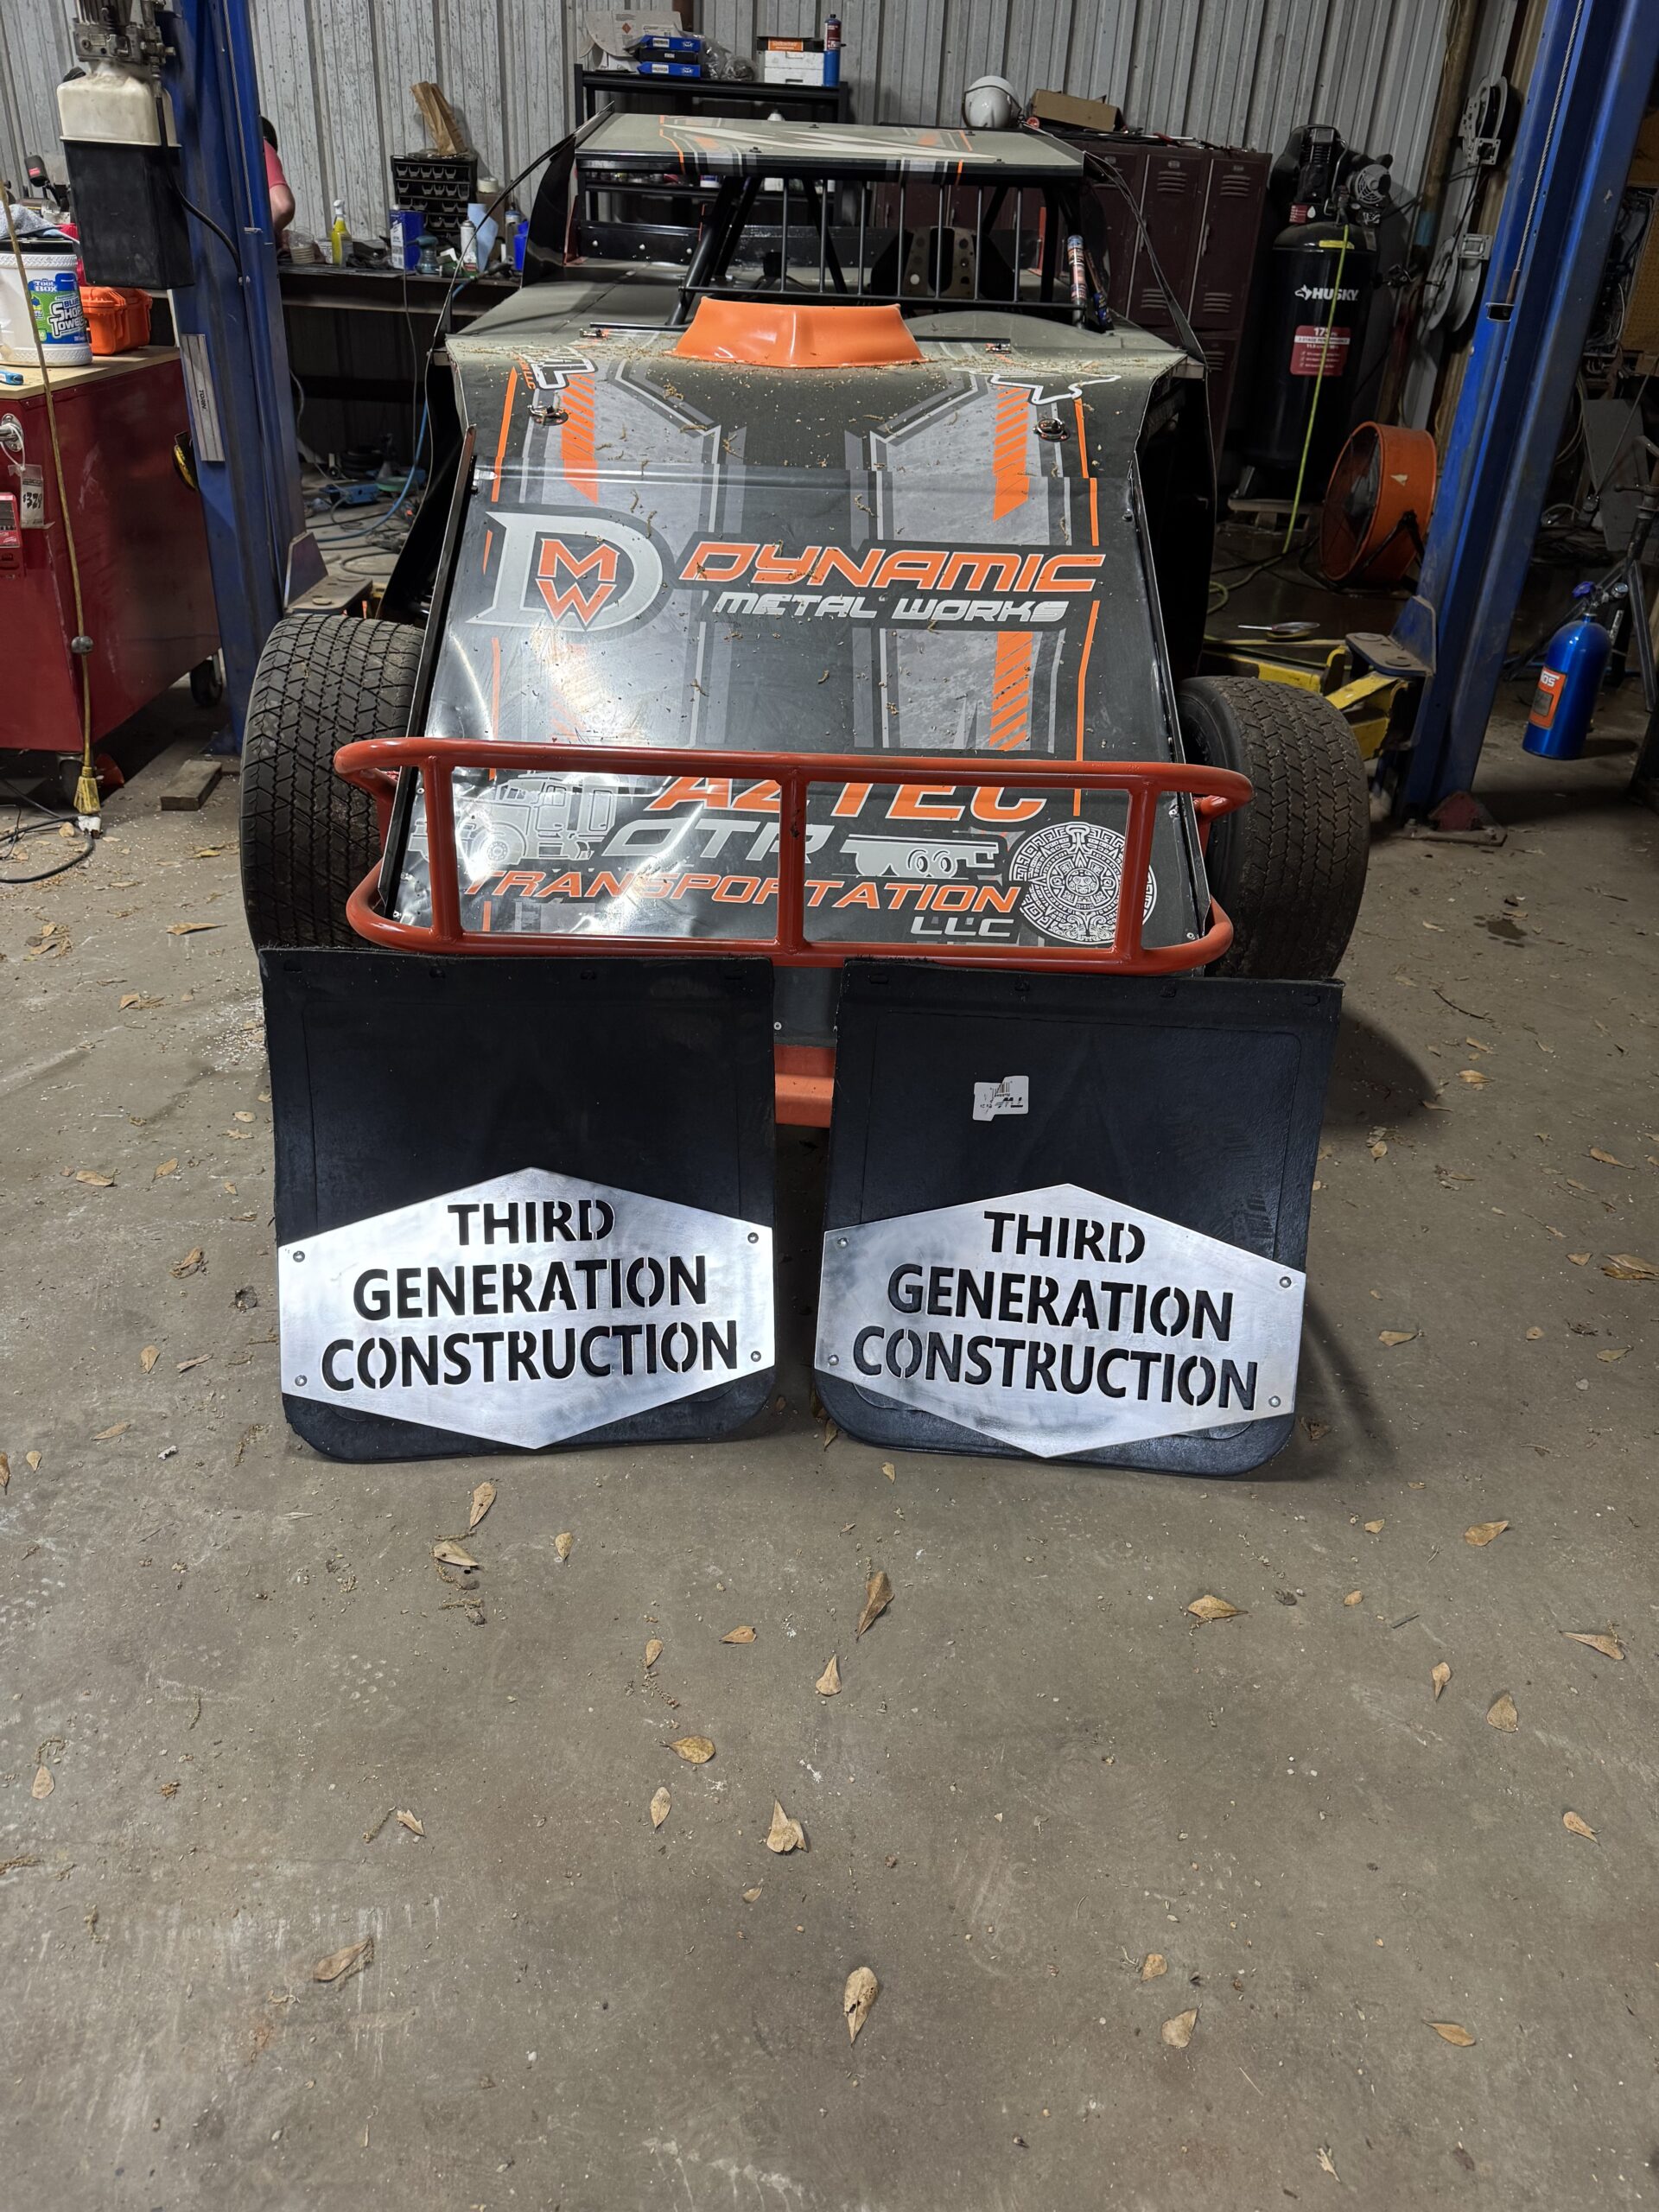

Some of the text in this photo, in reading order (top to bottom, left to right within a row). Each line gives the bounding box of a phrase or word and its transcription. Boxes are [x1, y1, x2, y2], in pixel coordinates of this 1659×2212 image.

[1312, 288, 1359, 301] HUSKY
[679, 541, 1106, 593] DYNAMIC
[713, 592, 1070, 624] METAL WORKS
[601, 817, 835, 864] OTR
[910, 916, 1015, 938] LLC
[448, 1198, 614, 1245] THIRD
[983, 1211, 1145, 1263] THIRD
[353, 1255, 707, 1320] GENERATION
[887, 1263, 1233, 1341] GENERATION
[321, 1320, 738, 1391] CONSTRUCTION
[853, 1325, 1258, 1410] CONSTRUCTION
